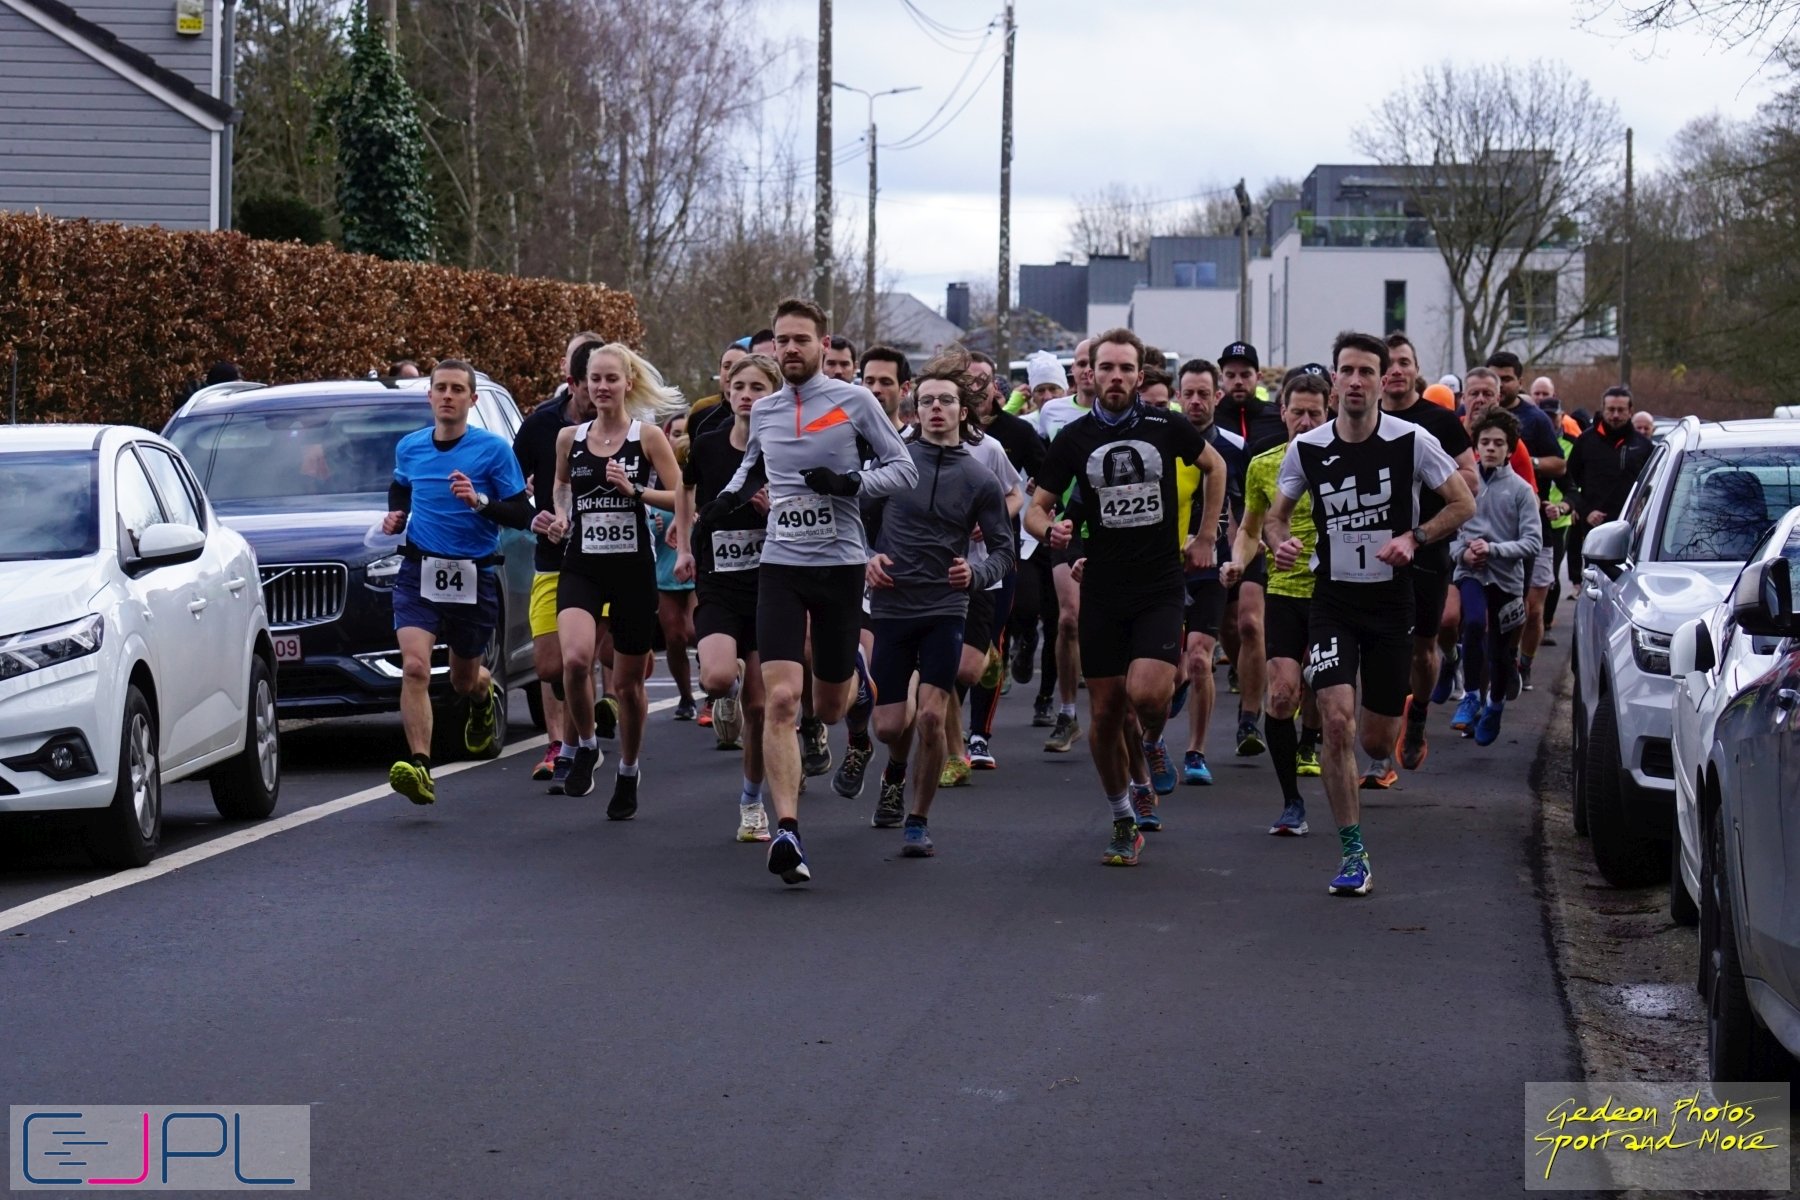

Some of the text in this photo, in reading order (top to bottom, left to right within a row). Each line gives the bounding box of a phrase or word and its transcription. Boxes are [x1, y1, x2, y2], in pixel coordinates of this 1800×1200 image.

[1319, 467, 1392, 516] MJ
[1103, 495, 1160, 516] 4225
[777, 507, 832, 529] 4905
[1326, 504, 1391, 534] SPORT
[584, 525, 635, 542] 4985
[1355, 544, 1366, 570] 1
[435, 569, 464, 592] 84
[275, 639, 298, 658] 09
